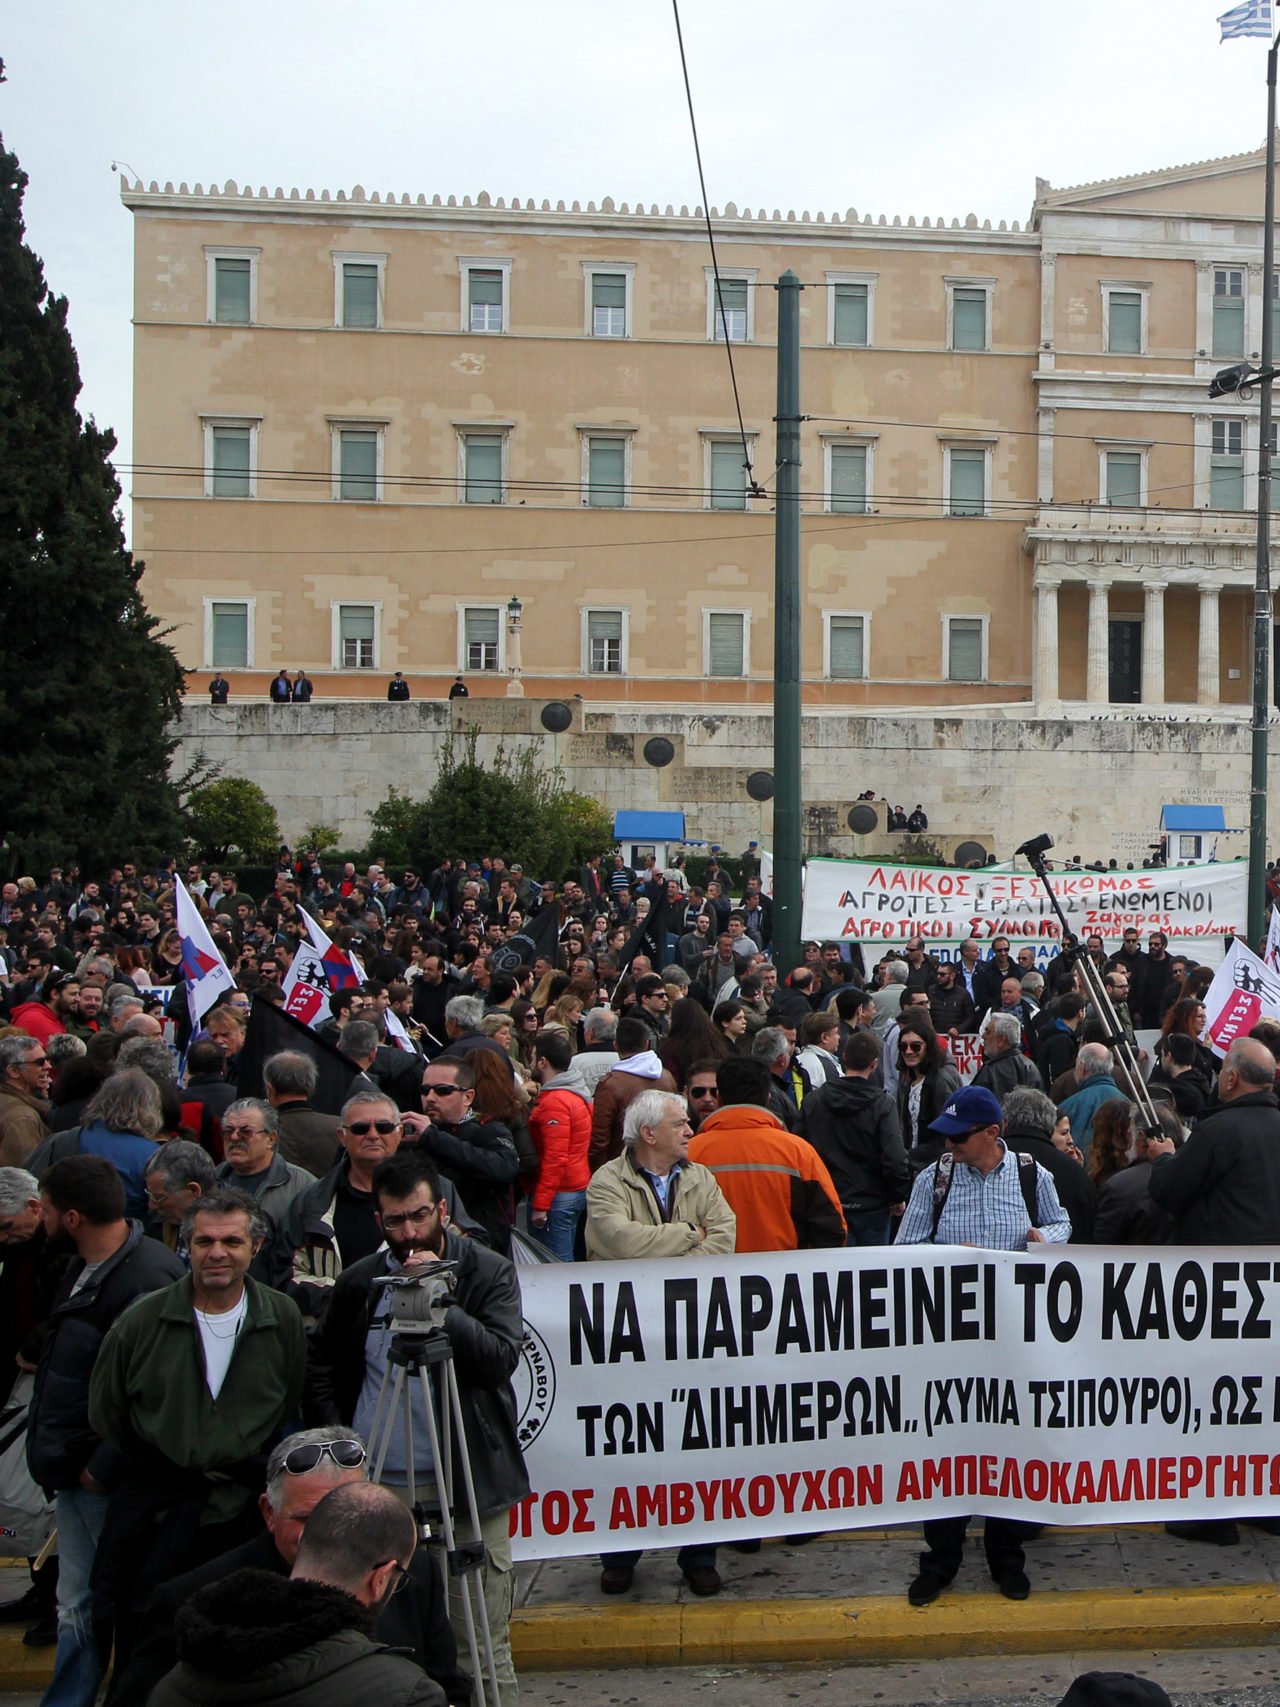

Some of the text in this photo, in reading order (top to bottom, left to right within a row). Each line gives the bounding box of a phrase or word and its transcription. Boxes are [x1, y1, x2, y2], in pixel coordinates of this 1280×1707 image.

[840, 889, 954, 917] ΑΓΡΟΤΕΣ
[1098, 890, 1214, 913] ΕΝΩΜΕΝΟΙ
[867, 866, 971, 897] ΛΑΪΚΟΣ
[840, 916, 954, 938] ΑΓΡΟΤΙΚΟΙ
[568, 1280, 646, 1365] ΝΑ
[664, 1263, 997, 1361] ΠΑΡΑΜΕΙΝΕΙ
[1014, 1260, 1083, 1343] ΤΟ
[576, 1401, 665, 1457] ΤΩΝ
[924, 1377, 1020, 1437] (ΧΥΜΑ
[1029, 1376, 1202, 1434] ΤΣΙΠΟΥΡΟ),
[1209, 1374, 1263, 1426] ΩΣ
[608, 1463, 884, 1531] ΑΜΒΥΚΟΥΧΩΝ
